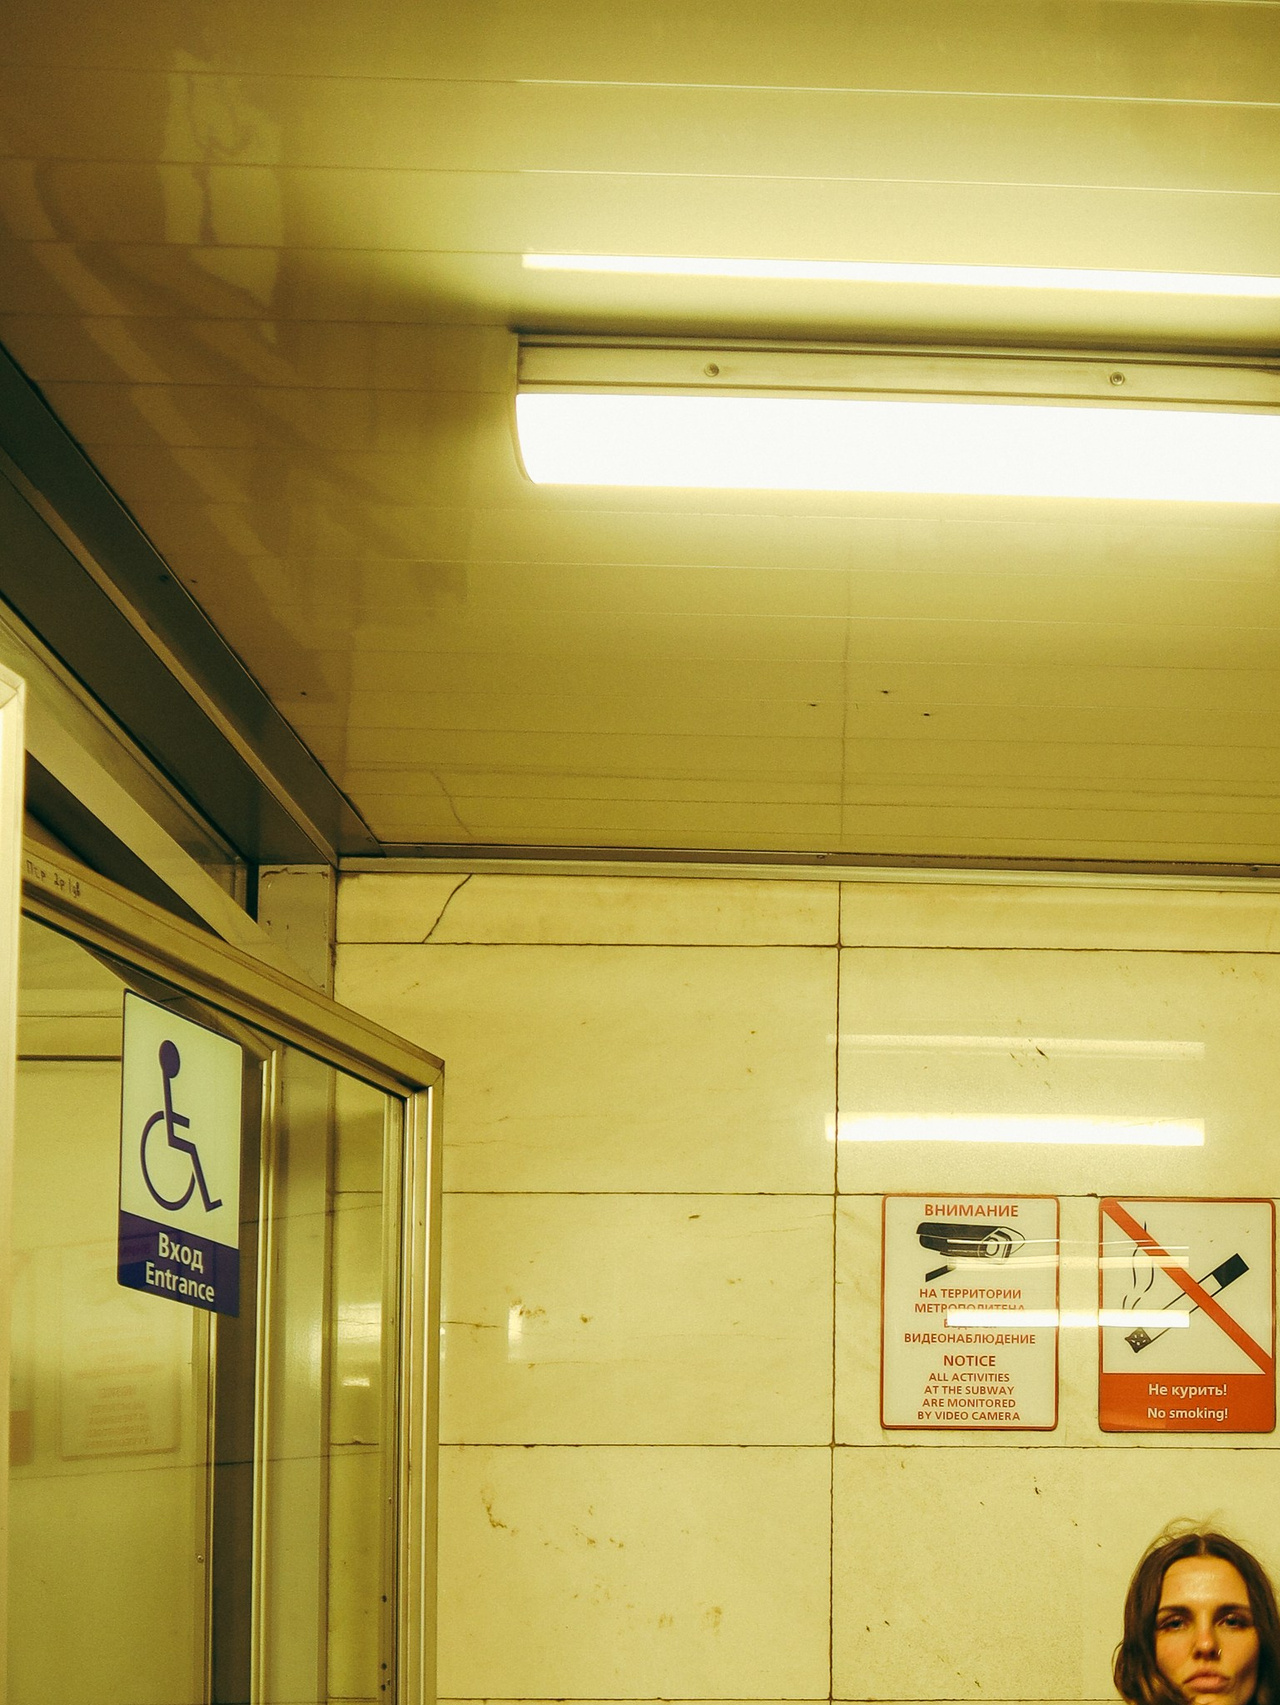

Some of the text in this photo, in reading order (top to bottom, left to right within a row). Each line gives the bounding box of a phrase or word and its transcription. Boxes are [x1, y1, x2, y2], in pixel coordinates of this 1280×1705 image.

[924, 1204, 1019, 1218] ВНИМАНИЕ
[158, 1231, 204, 1275] Вход
[145, 1260, 215, 1303] Entrance
[919, 1288, 1022, 1299] НА ТЕРРИТОРИИ
[904, 1333, 1036, 1345] ВИДЕОНАБЛЮДЕНИЕ
[943, 1355, 996, 1367] NOTICE
[928, 1373, 1010, 1383] ALL ACTIVITIES
[924, 1385, 1015, 1396] AT THE SUBWAY
[1148, 1383, 1227, 1399] Не курить!
[922, 1398, 1016, 1408] ARE MONITORED
[917, 1411, 1021, 1421] BY VIDEO CAMERA
[1147, 1406, 1228, 1422] No smoking!
